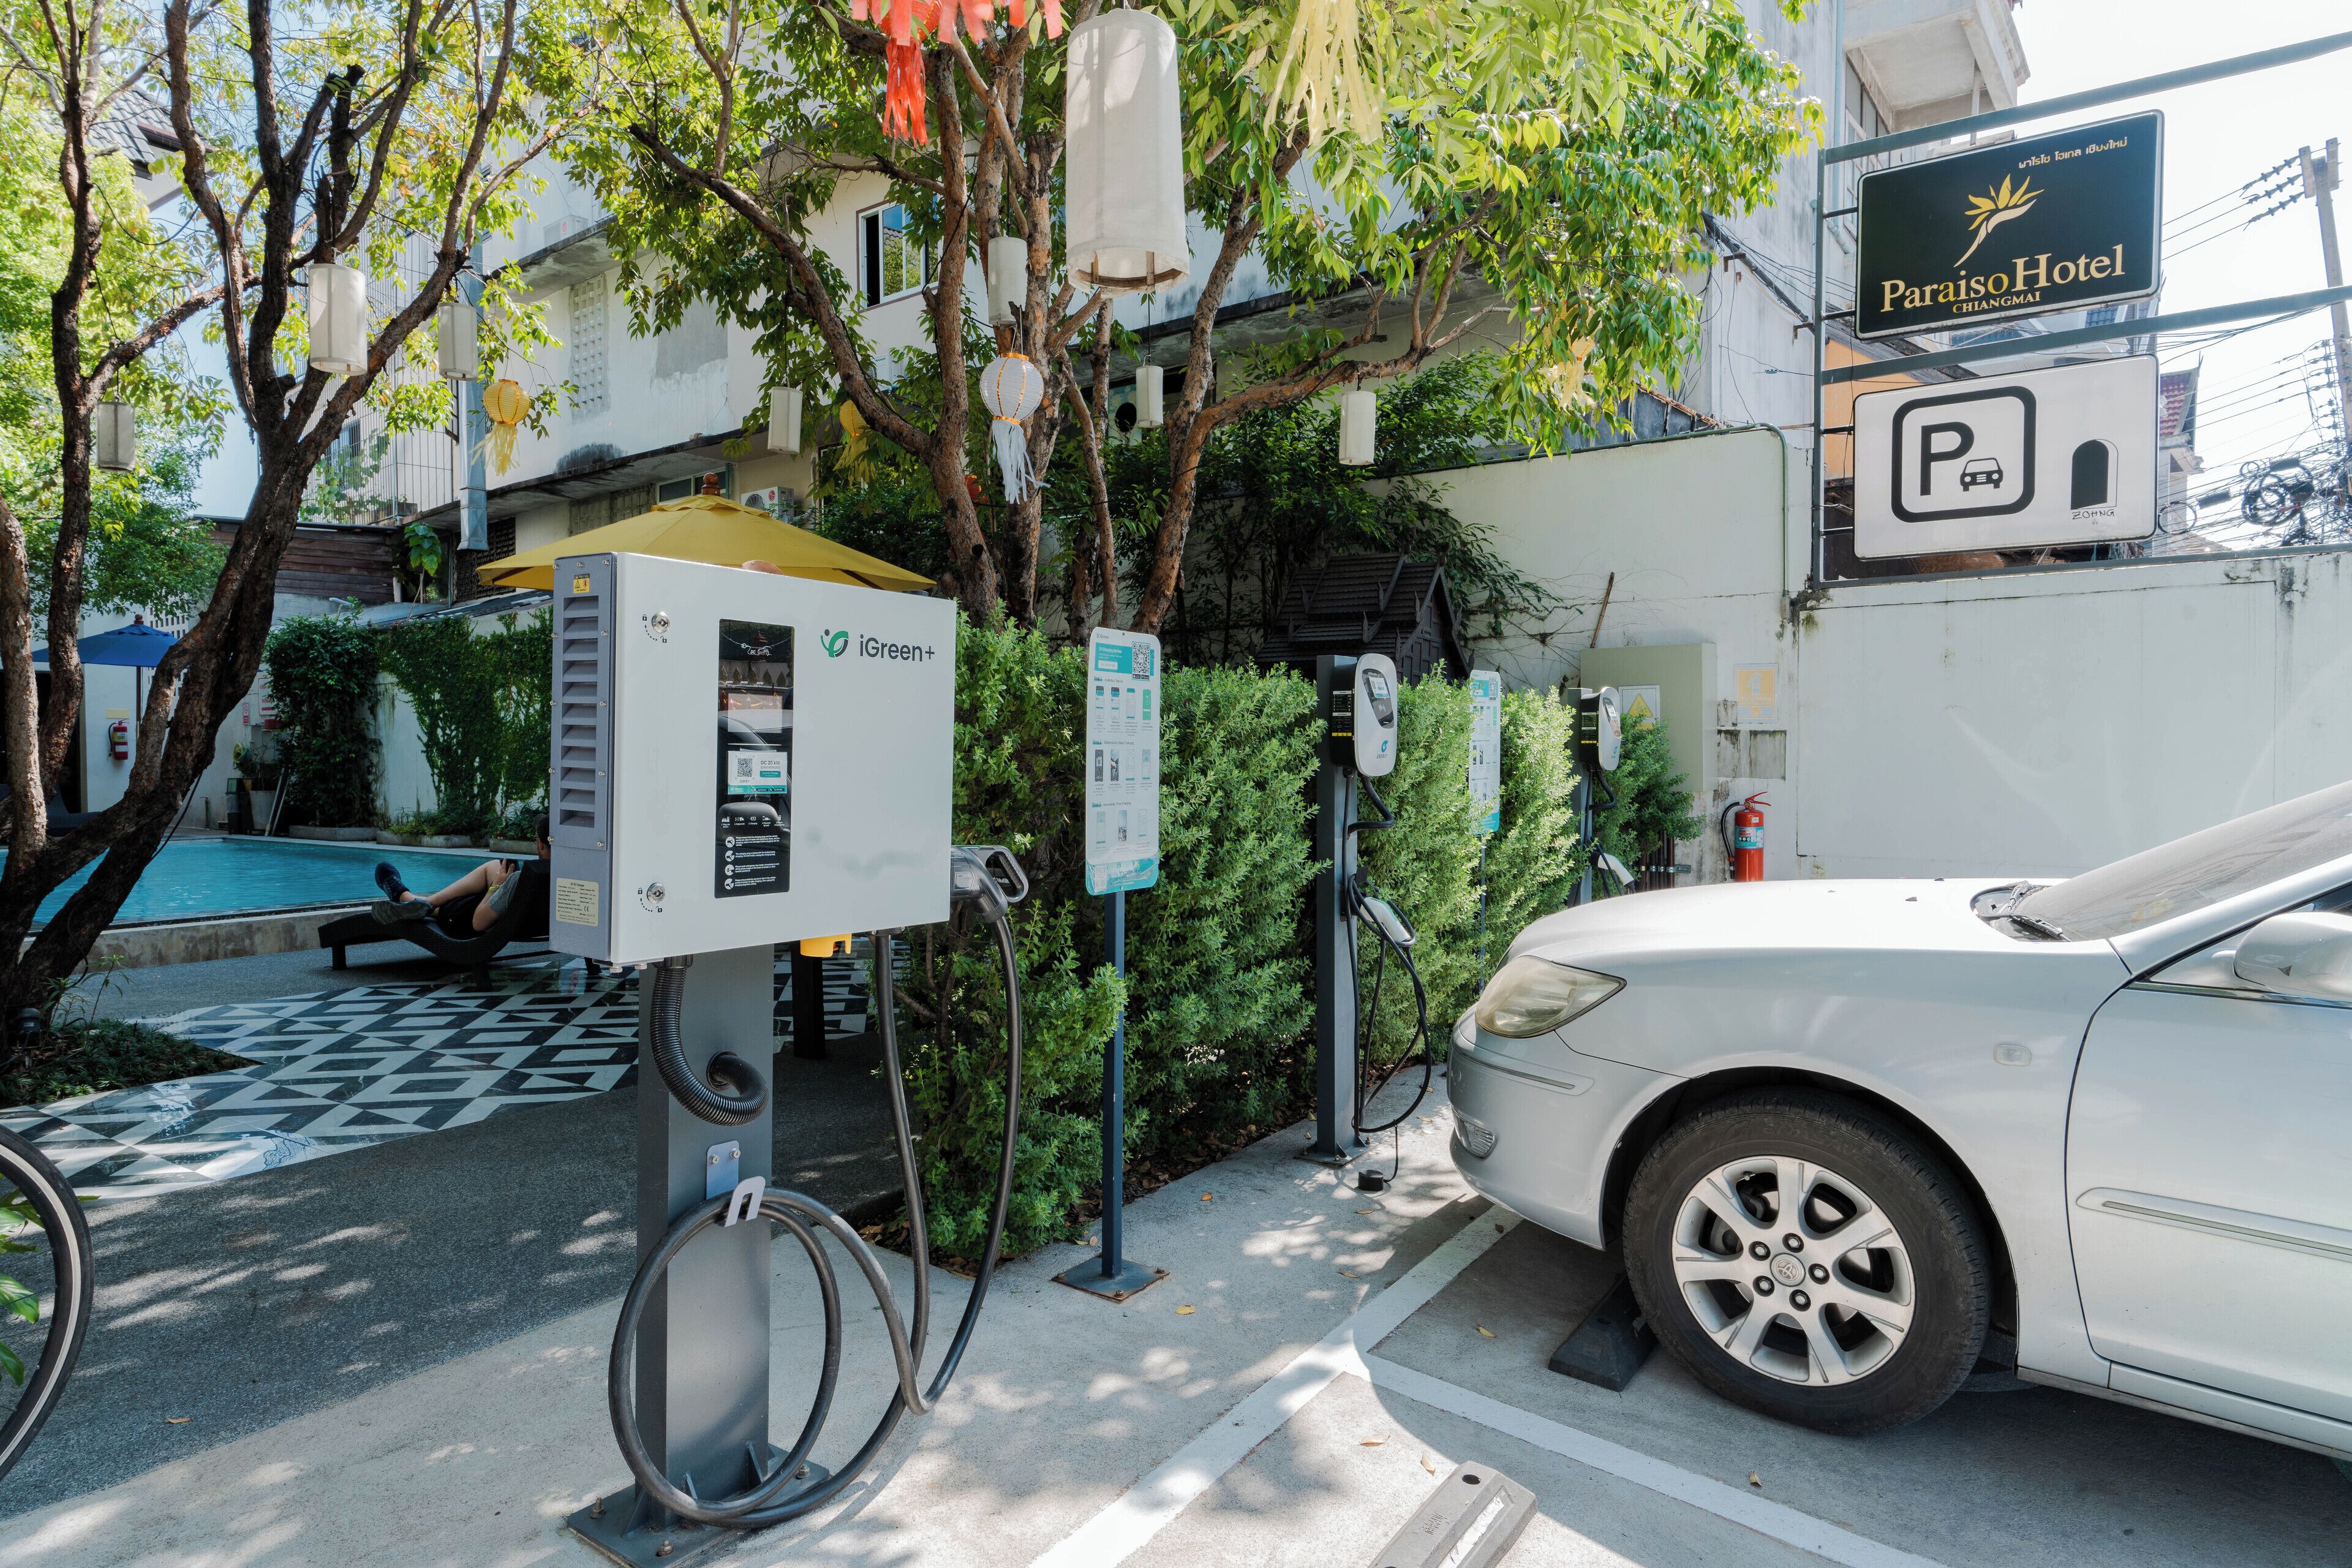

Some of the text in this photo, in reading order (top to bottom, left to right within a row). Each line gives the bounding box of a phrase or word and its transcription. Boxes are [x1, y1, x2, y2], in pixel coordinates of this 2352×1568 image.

[1953, 291, 2041, 314] CHIANGMAI
[1920, 421, 1975, 496] P
[860, 634, 935, 662] iGreen+
